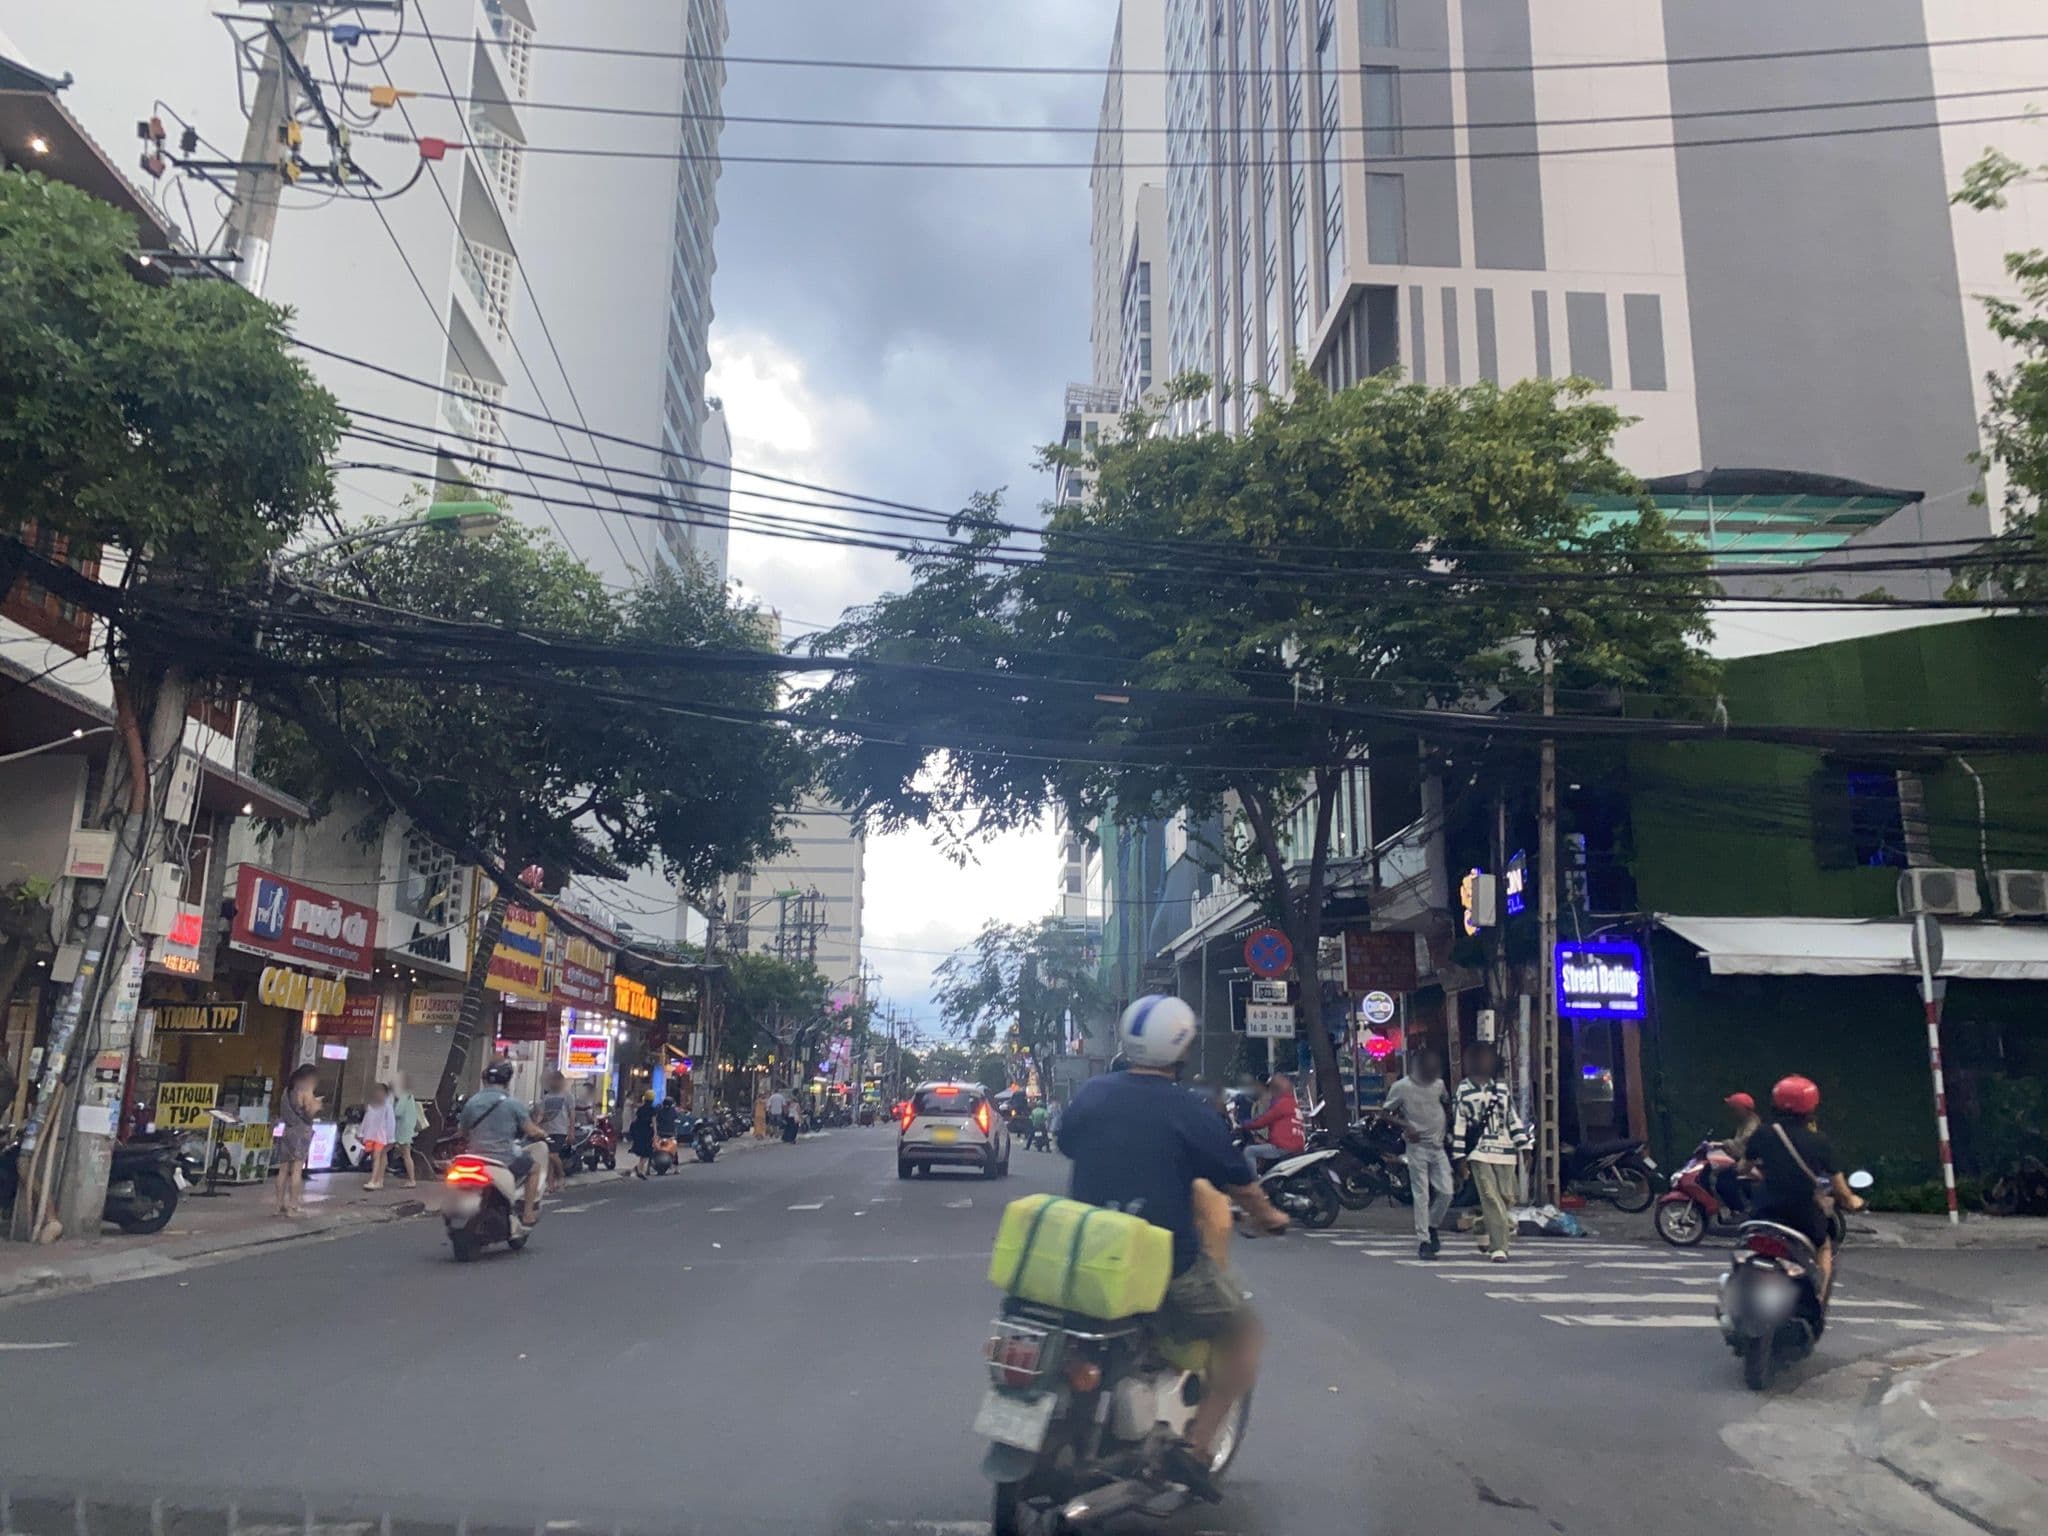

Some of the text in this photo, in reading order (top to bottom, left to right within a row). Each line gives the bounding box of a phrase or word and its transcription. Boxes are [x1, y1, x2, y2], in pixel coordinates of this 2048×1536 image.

[1562, 964, 1640, 997] Street Dating
[212, 1007, 238, 1029] ТУР
[160, 1086, 213, 1104] КАТЮША
[170, 1106, 200, 1124] ТУР
